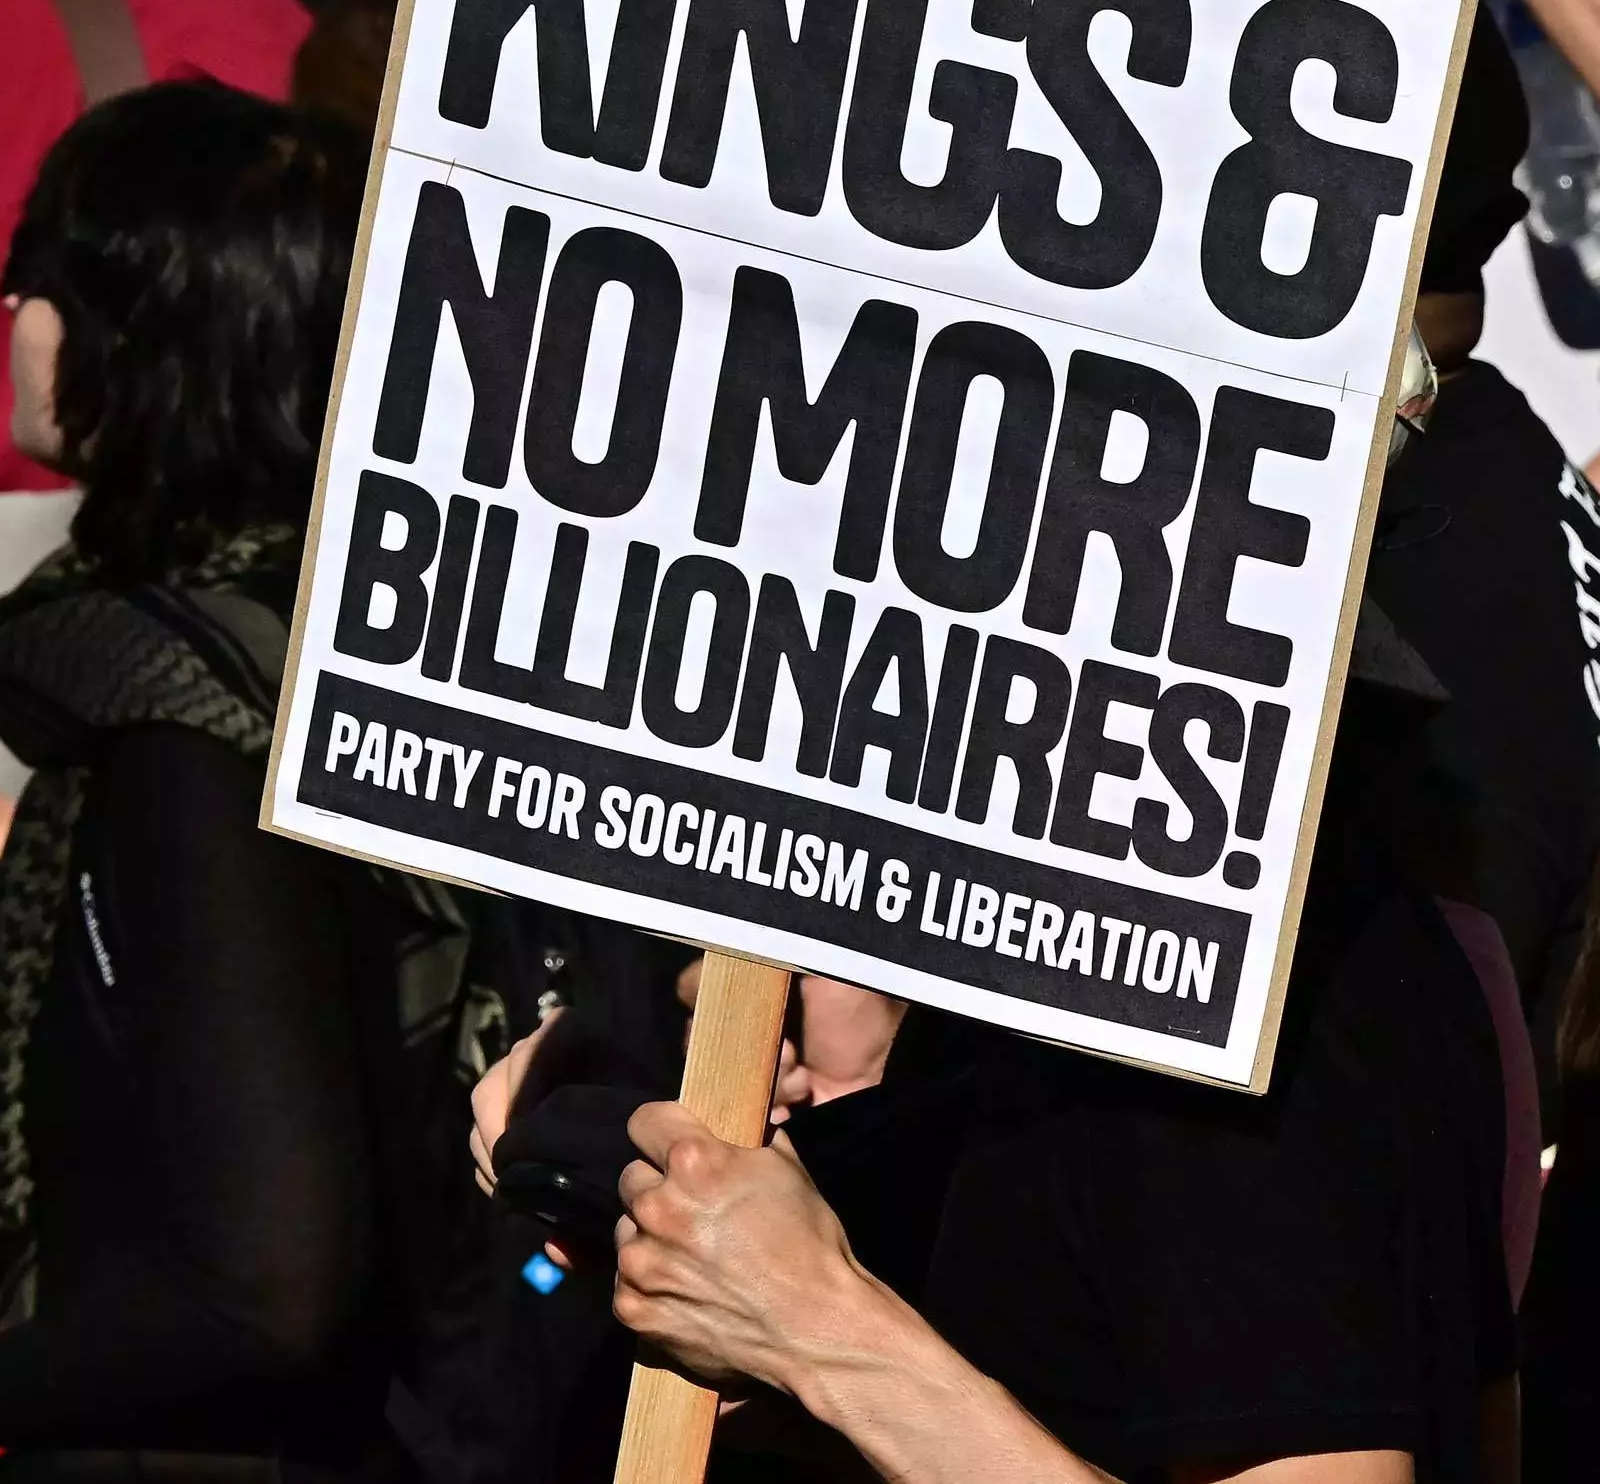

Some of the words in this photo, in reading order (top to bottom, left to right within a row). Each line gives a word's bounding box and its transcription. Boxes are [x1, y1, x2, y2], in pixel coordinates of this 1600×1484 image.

[373, 181, 683, 517] NO
[694, 265, 1335, 687] MORE
[325, 711, 483, 808] PARTY
[488, 757, 586, 839] FOR
[595, 786, 868, 911] SOCIALISM
[876, 859, 912, 922] &
[920, 871, 1219, 1003] LIBERATION
[333, 470, 1290, 890] BILLIONAIRES!
